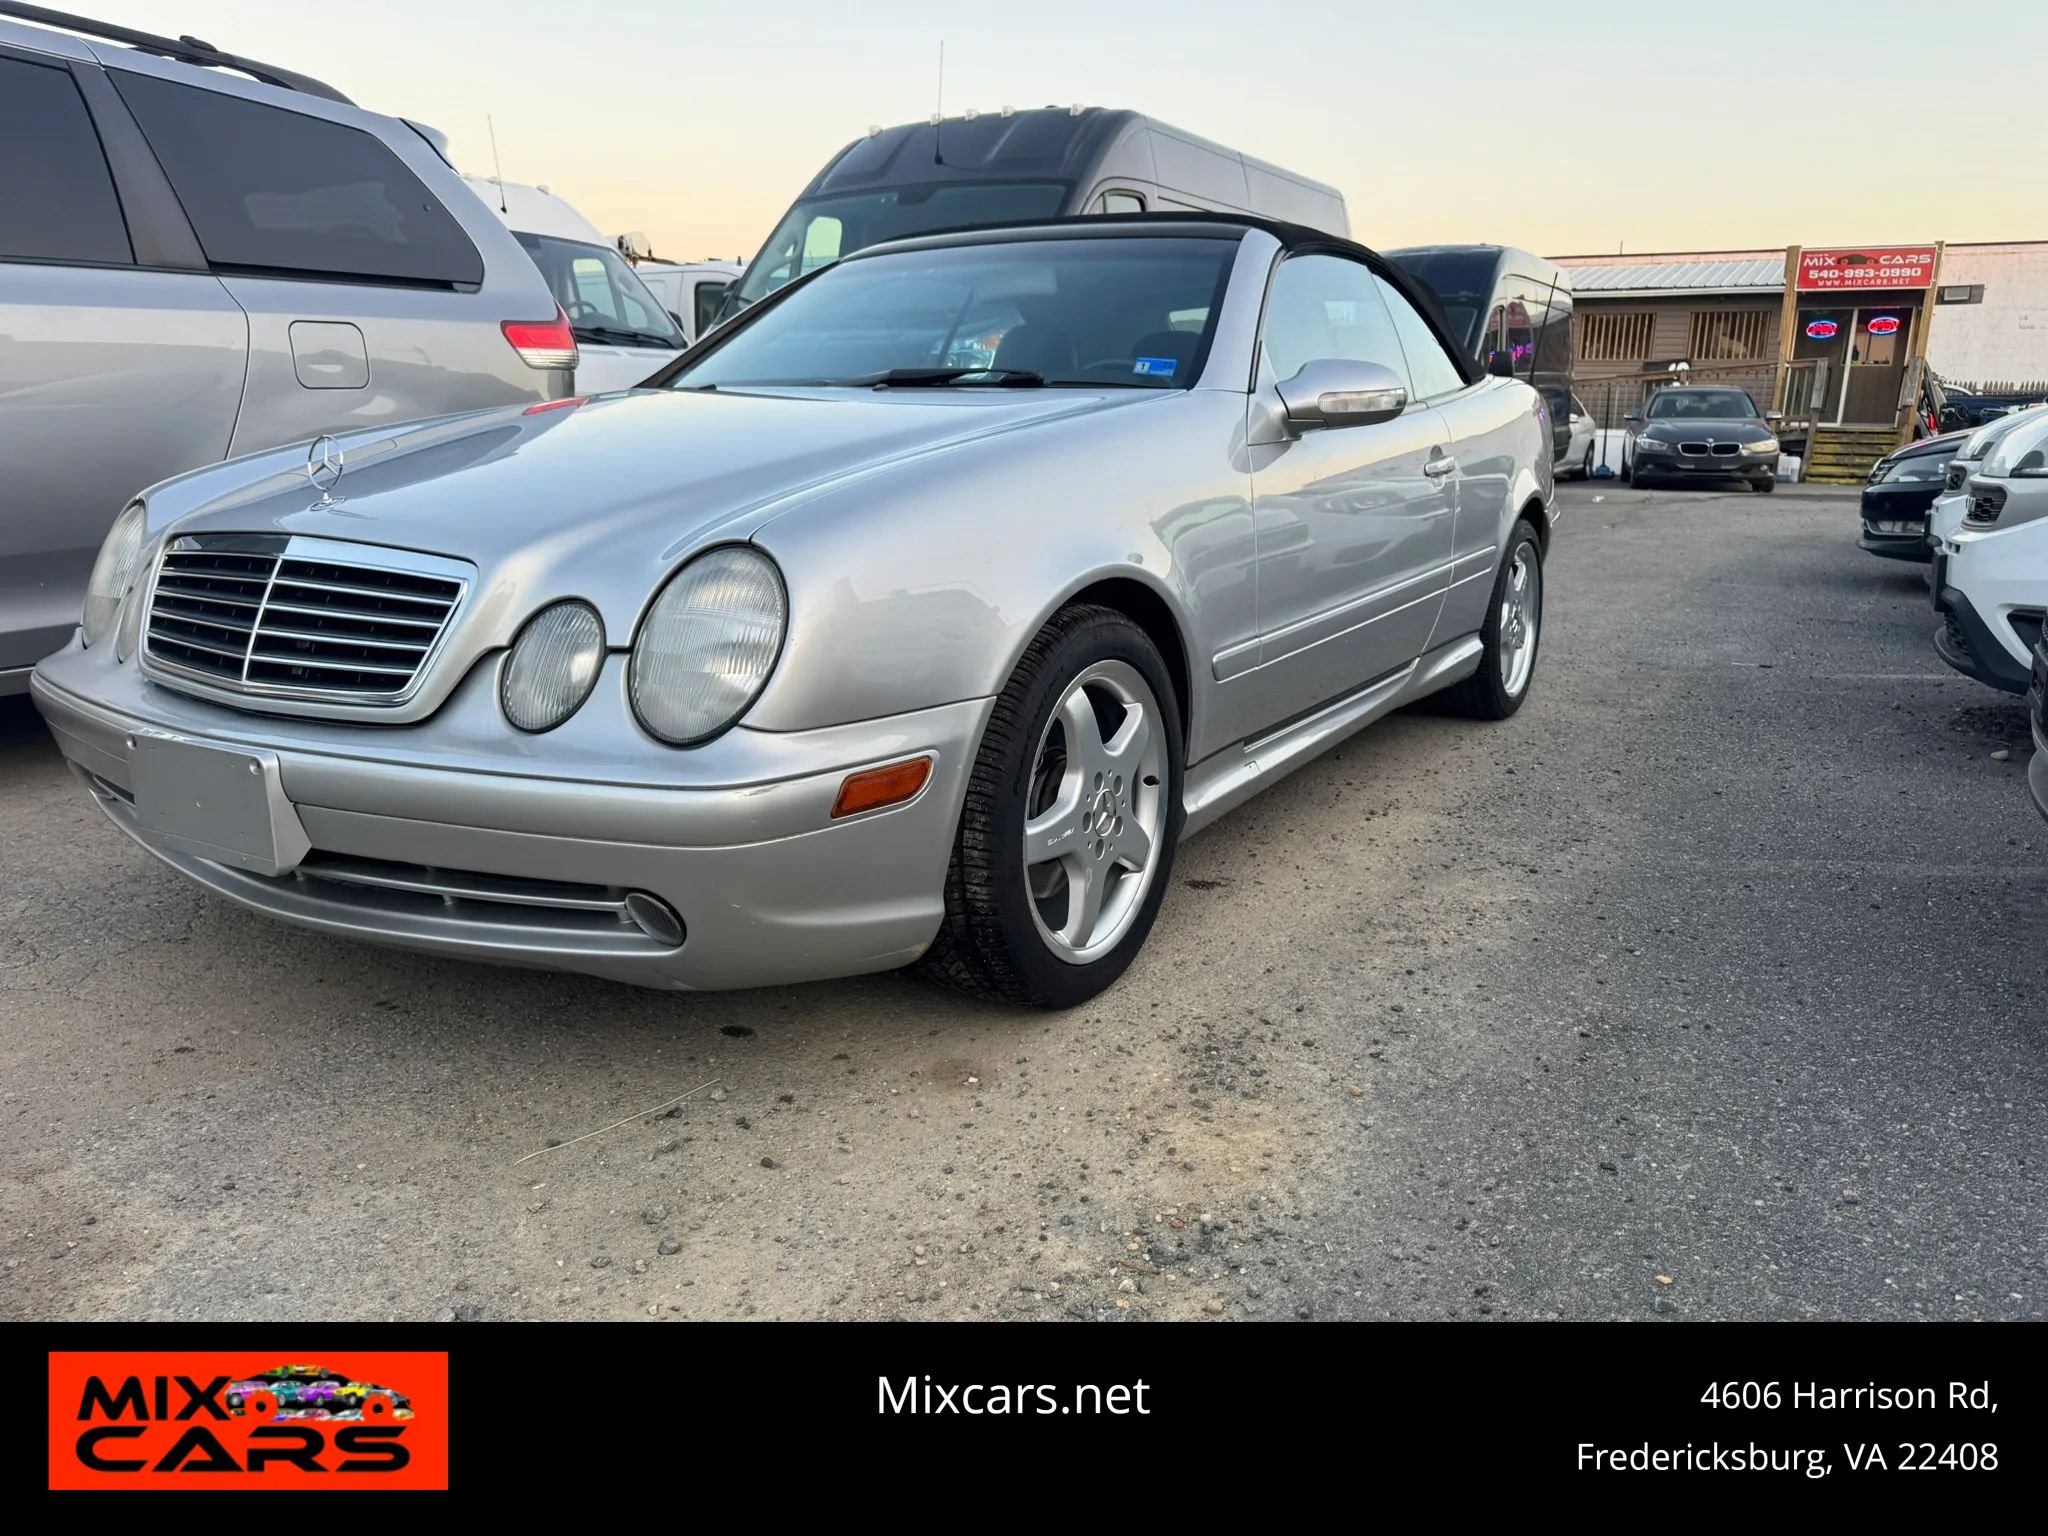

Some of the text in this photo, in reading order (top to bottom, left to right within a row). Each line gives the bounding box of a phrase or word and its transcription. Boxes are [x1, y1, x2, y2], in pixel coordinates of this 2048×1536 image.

[1803, 254, 1931, 266] MIX CARS
[1808, 267, 1921, 279] 540-993-0990
[1817, 278, 1909, 286] WWW.MIXCARS.NET
